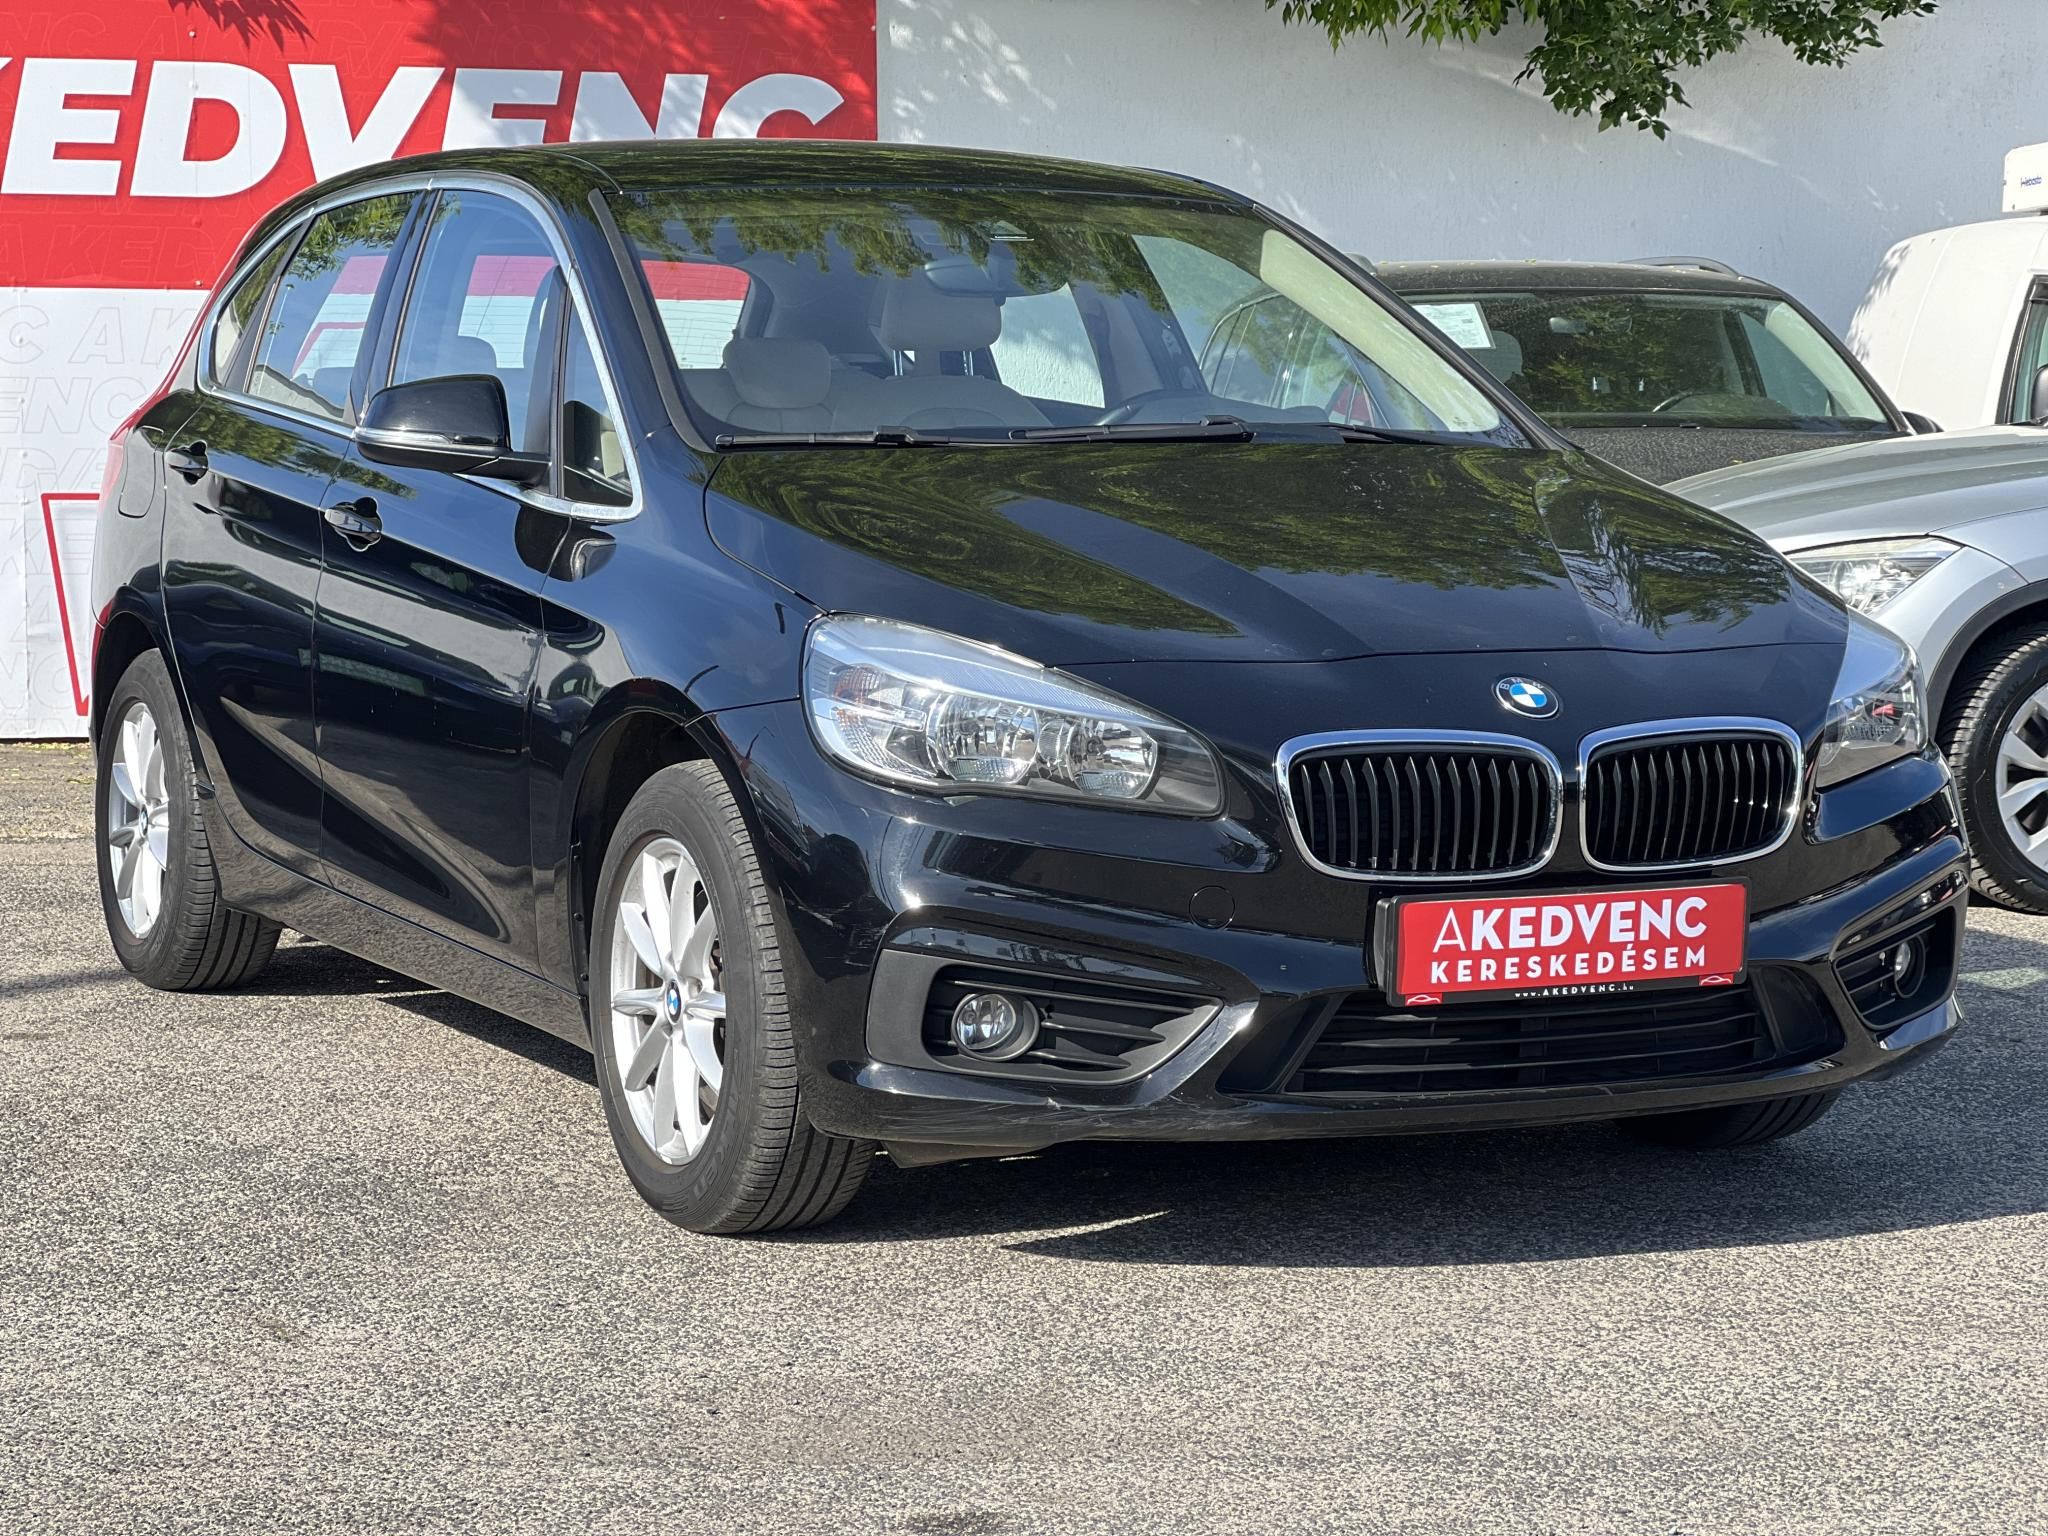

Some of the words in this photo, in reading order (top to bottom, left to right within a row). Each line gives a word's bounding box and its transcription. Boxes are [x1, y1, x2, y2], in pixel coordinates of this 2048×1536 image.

[0, 57, 844, 198] EDVENC
[1432, 896, 1708, 953] AKEDVENC
[1430, 942, 1706, 984] KERESKEDÉSEM
[1514, 982, 1635, 999] www.AKEDVENC.hu
